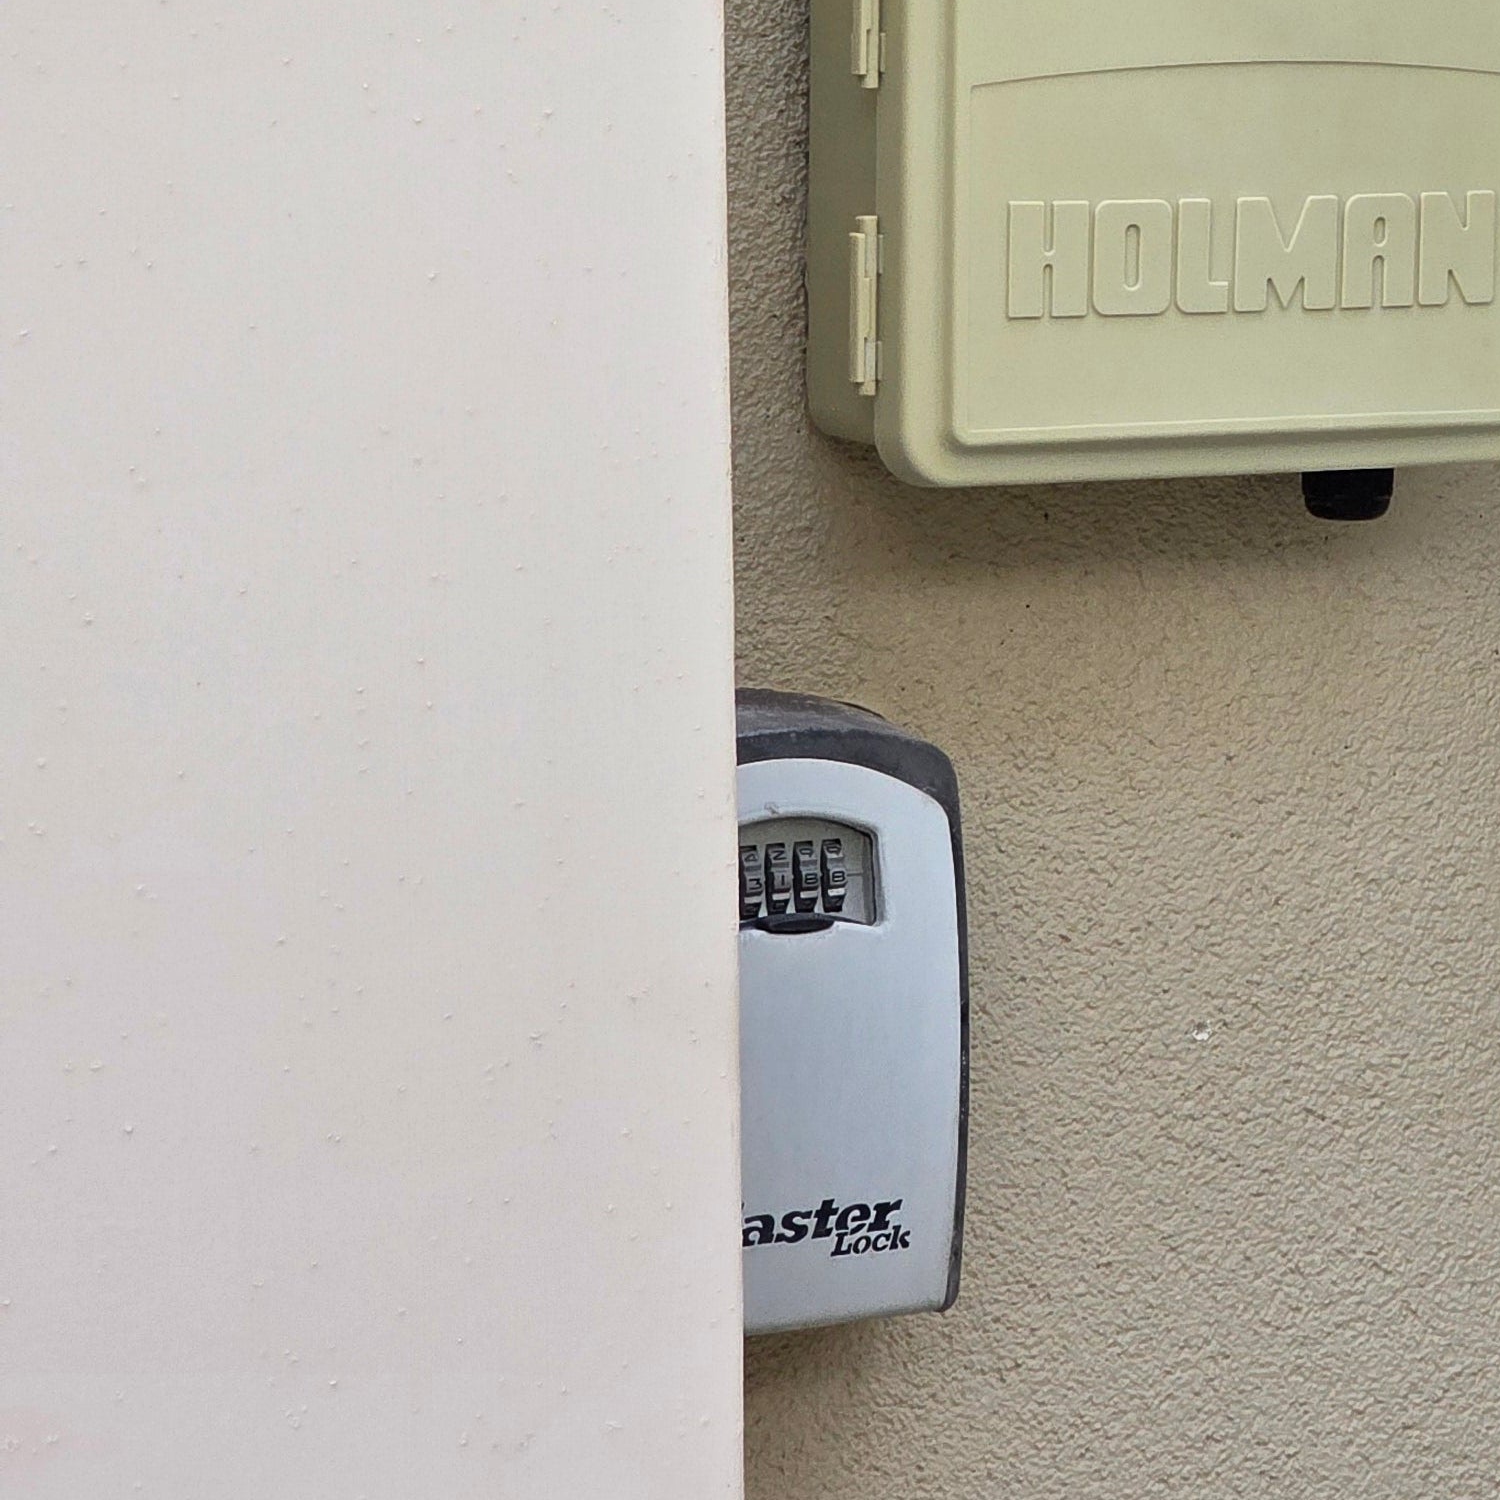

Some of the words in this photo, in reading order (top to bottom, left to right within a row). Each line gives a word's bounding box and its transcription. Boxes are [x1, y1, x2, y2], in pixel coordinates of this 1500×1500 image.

[1007, 189, 1496, 320] HOLMAN
[741, 1198, 903, 1248] aster
[830, 1225, 911, 1257] Lock
